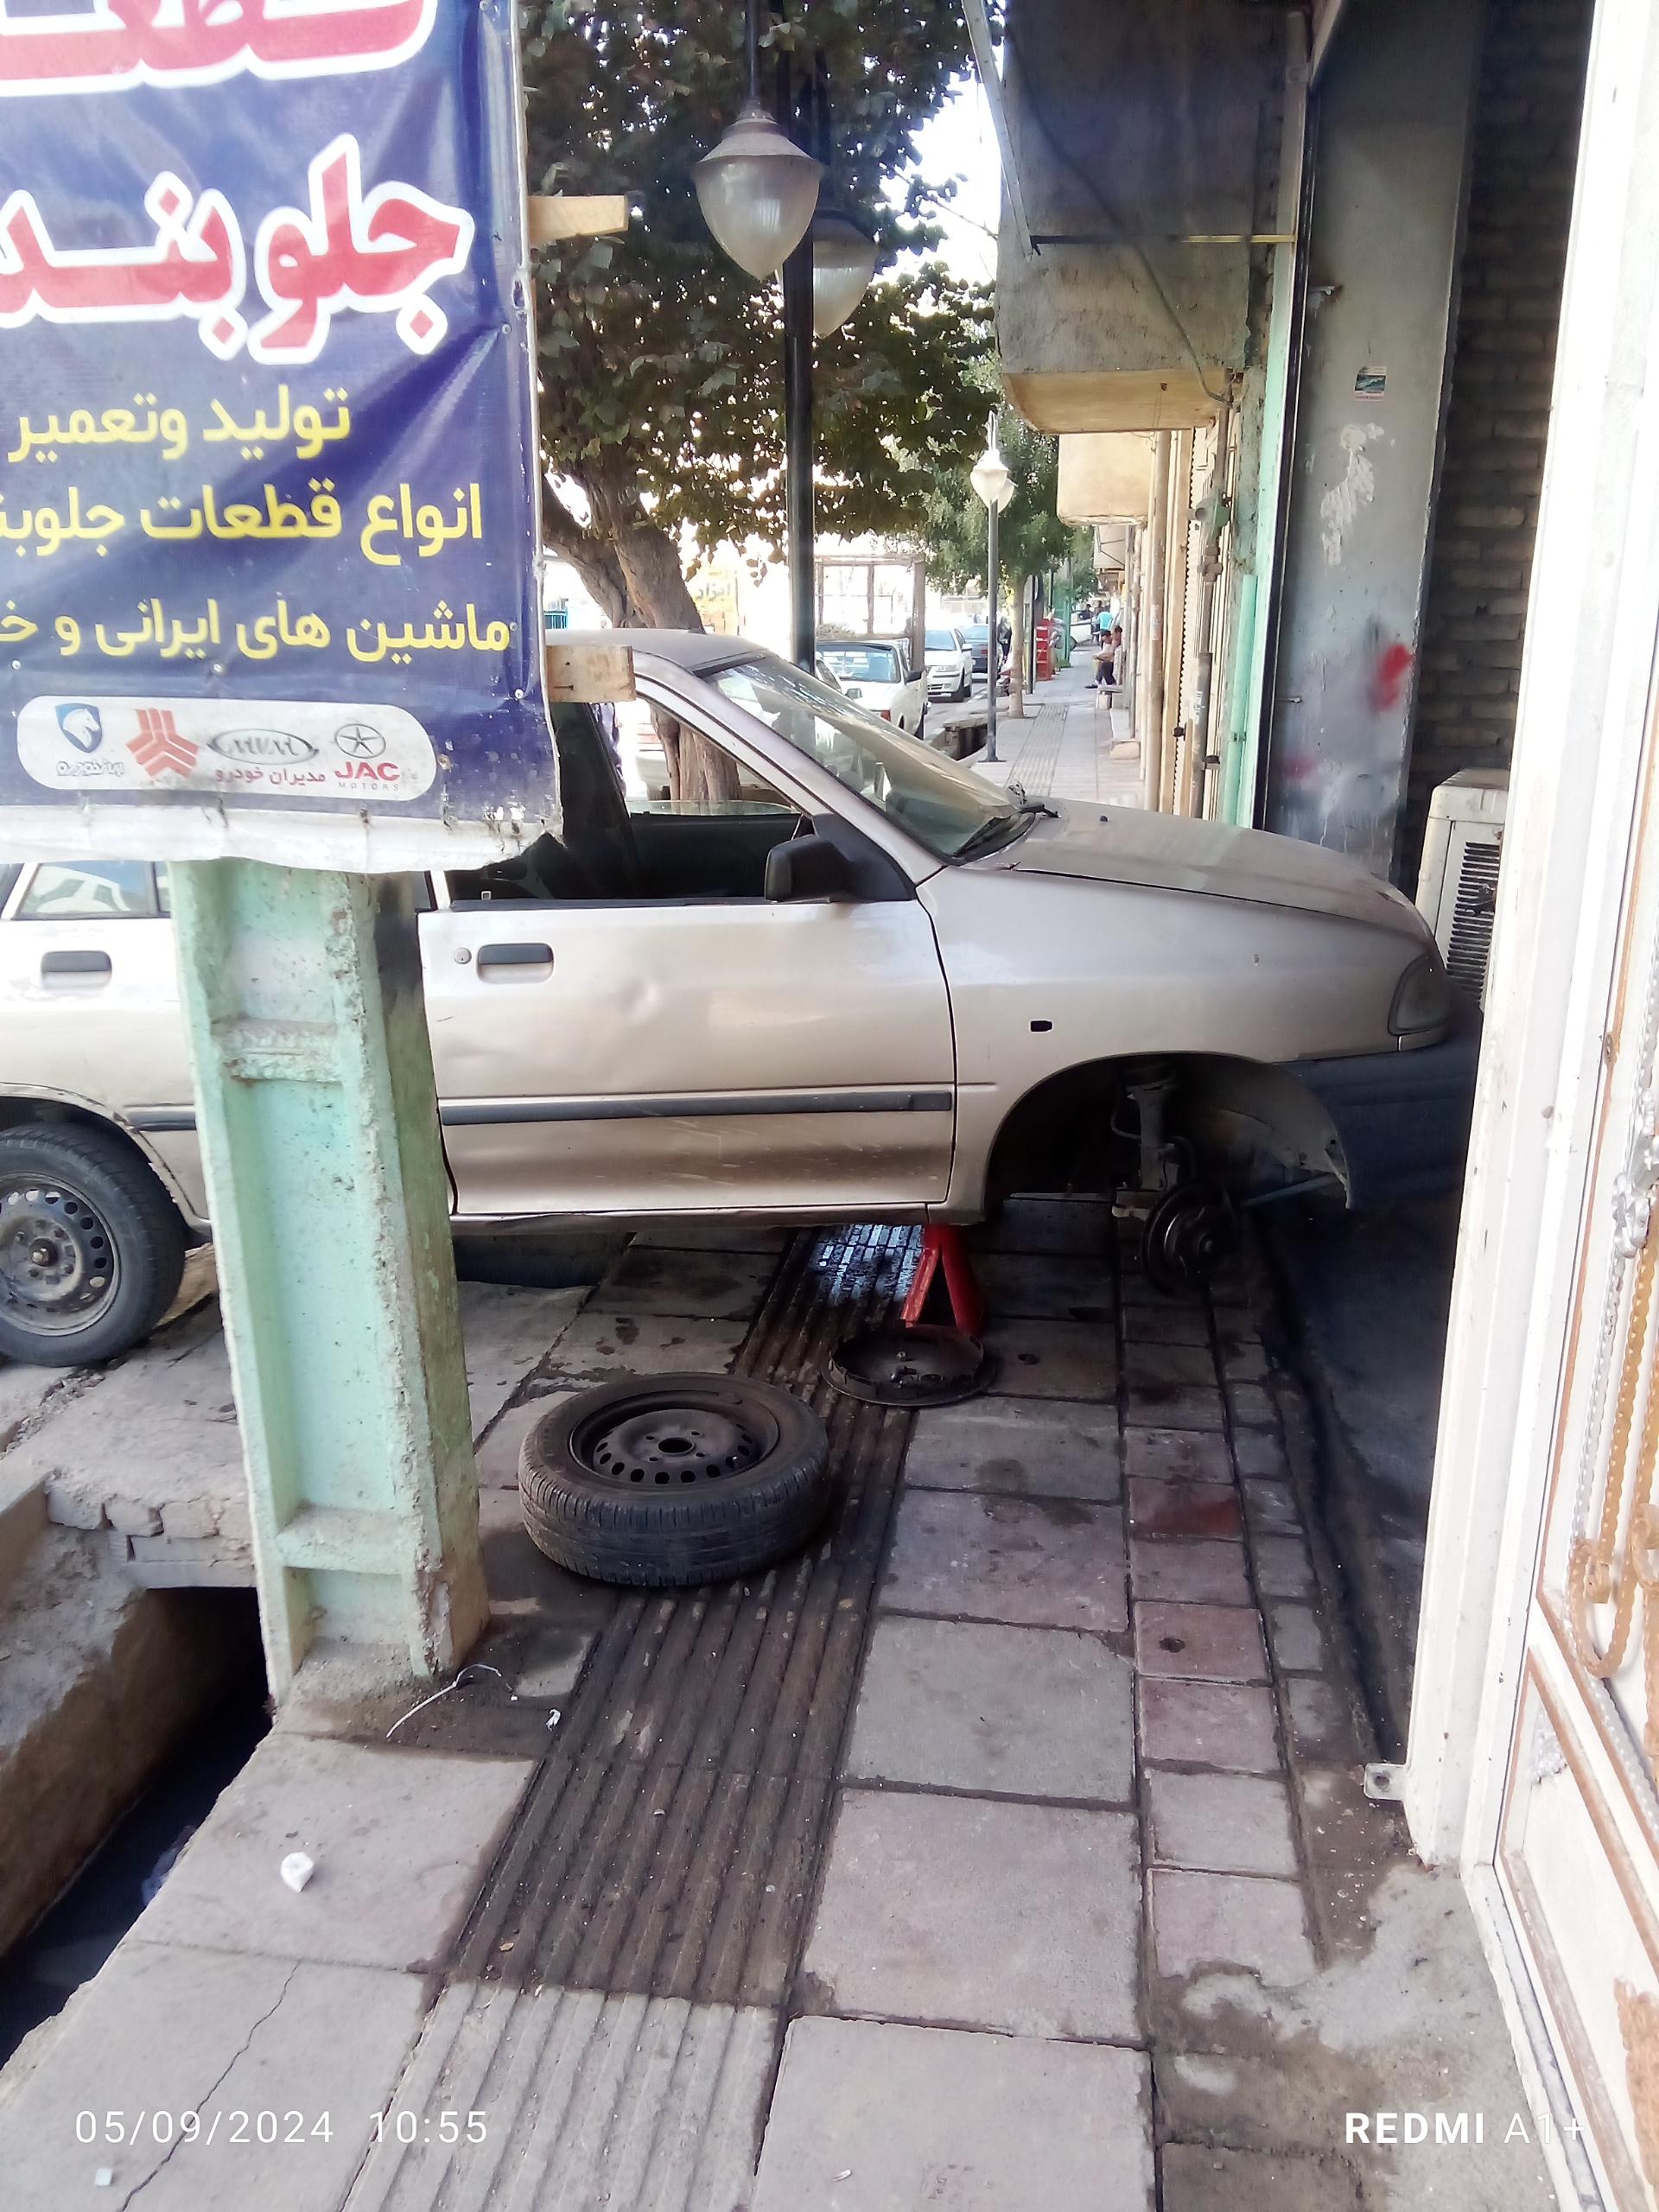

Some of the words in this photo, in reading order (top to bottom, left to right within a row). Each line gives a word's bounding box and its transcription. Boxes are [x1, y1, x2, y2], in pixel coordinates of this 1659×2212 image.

[203, 385, 351, 460] تولید
[140, 478, 343, 540] قطعات
[359, 483, 483, 565] انواع
[54, 615, 81, 657] و
[95, 598, 220, 659] ایرانی
[236, 600, 331, 659] های
[346, 601, 511, 664] ماشین
[214, 766, 264, 784] خودرو
[269, 768, 327, 787] مدیران
[334, 761, 401, 782] JAC
[338, 781, 401, 792] MOTORS
